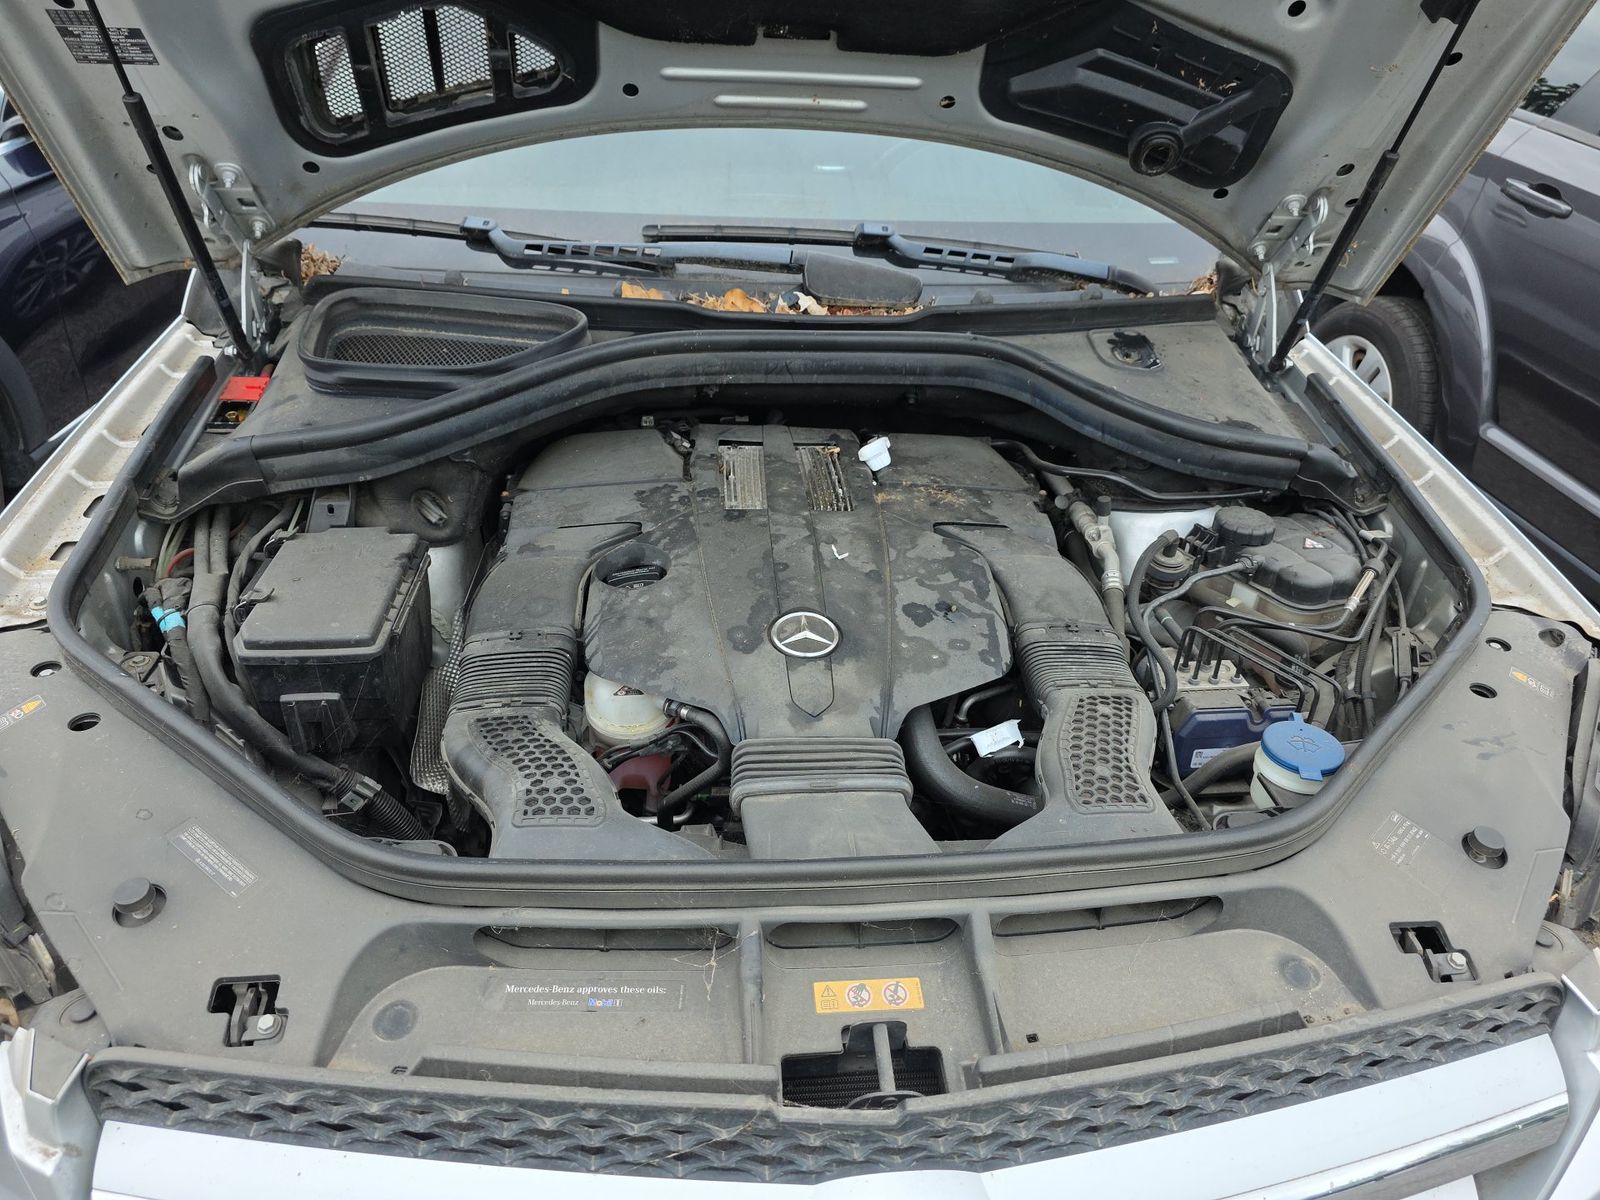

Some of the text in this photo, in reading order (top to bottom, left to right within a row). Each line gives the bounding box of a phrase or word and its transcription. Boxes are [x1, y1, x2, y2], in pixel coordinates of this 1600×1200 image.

[505, 984, 667, 995] Mercedes-Benz approves these oils:
[527, 998, 579, 1006] Mercedes-Benz
